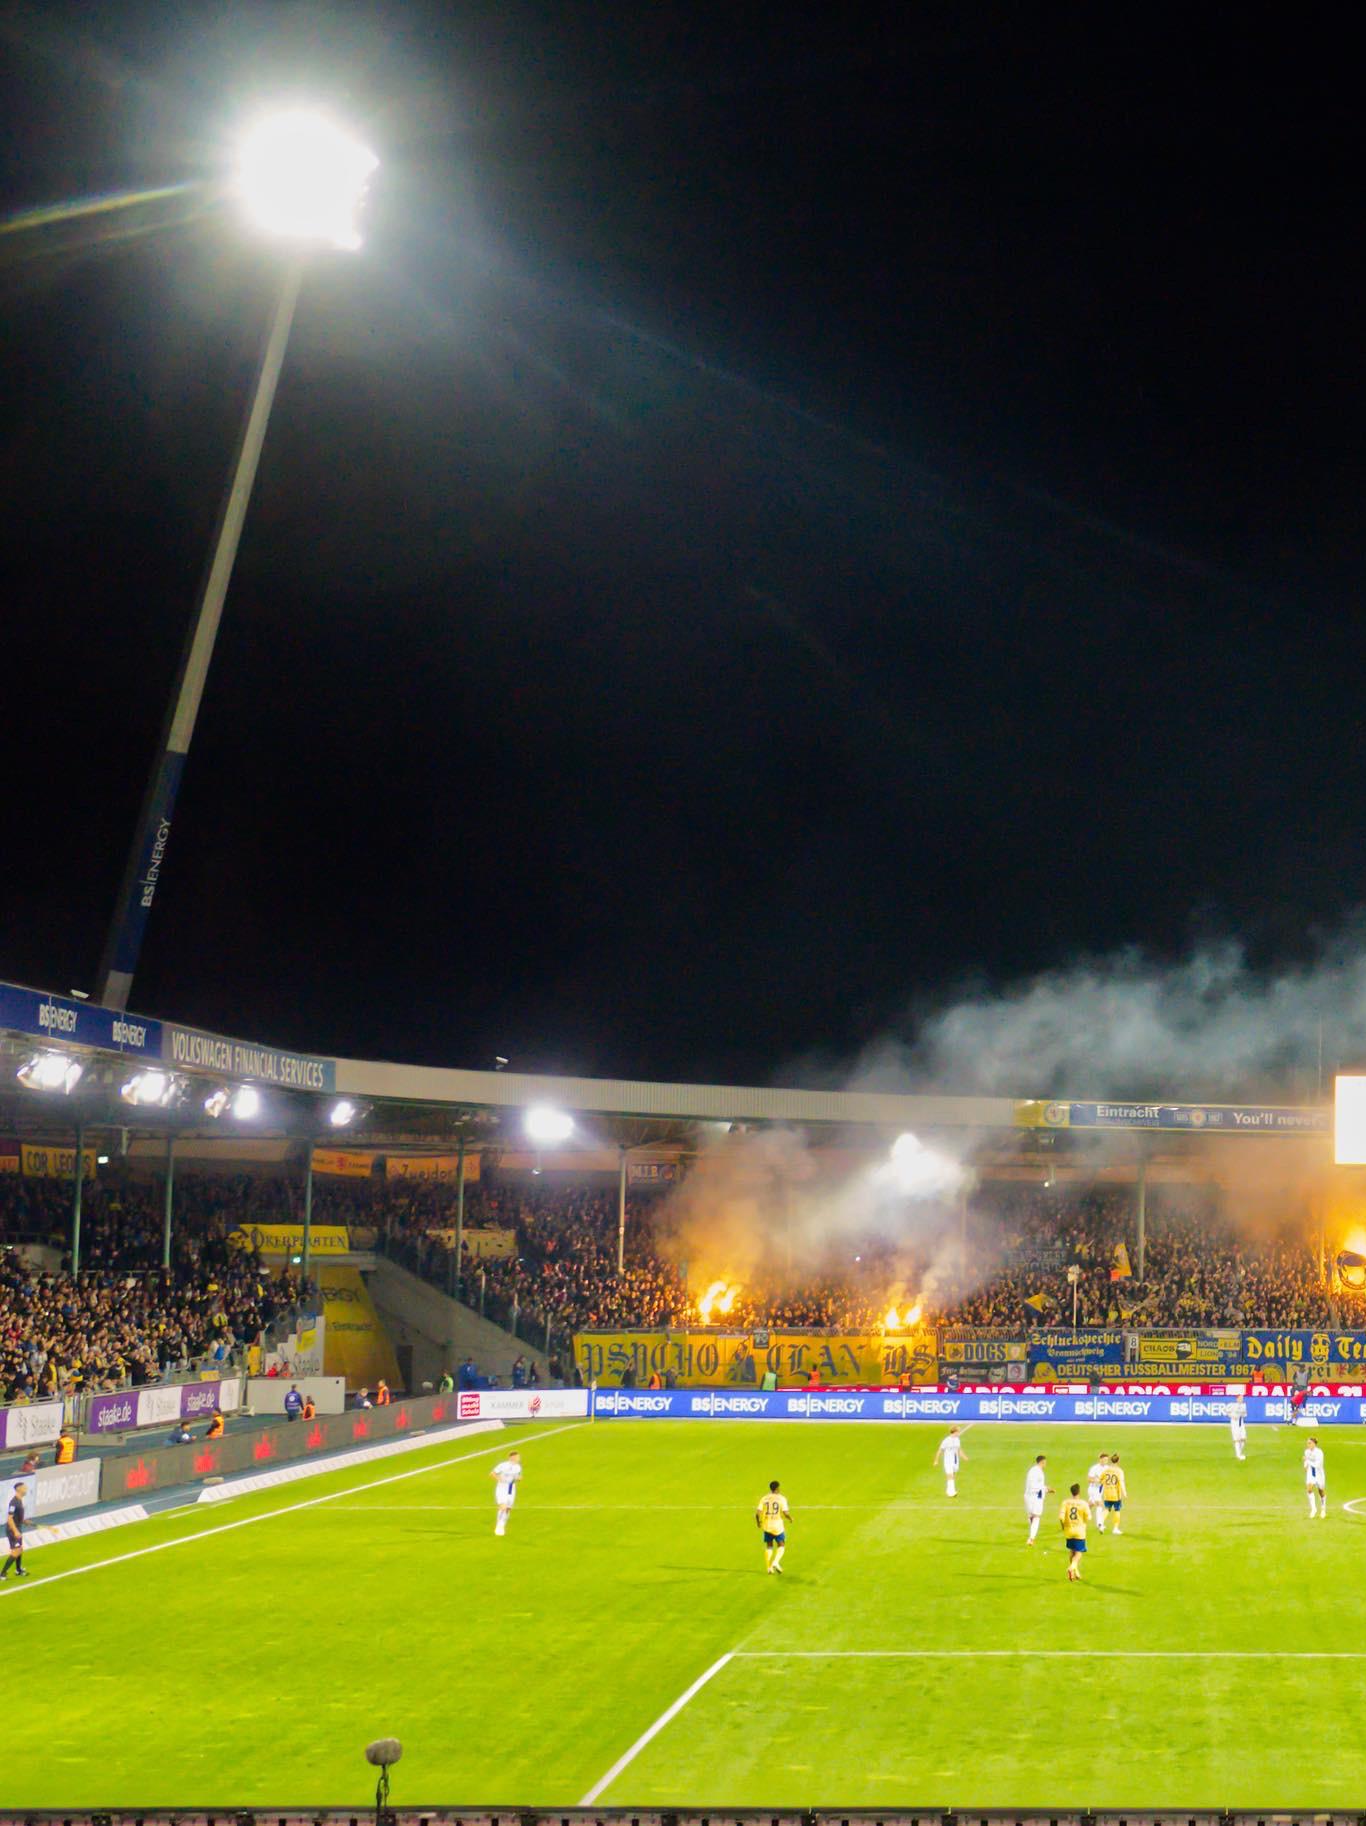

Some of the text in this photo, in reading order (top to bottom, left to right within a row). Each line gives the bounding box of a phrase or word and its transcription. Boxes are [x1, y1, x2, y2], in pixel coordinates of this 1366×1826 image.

[172, 1031, 324, 1088] VOLKSWAGEN FINANCIAL SERVICES
[1096, 1105, 1160, 1119] Eintracht
[964, 1343, 1007, 1361] DOGS
[1247, 1334, 1303, 1361] Daily
[581, 1341, 719, 1383] PSYCHO
[766, 1342, 866, 1378] CLAN
[1124, 1363, 1226, 1376] FUSSBALLMEISTER
[1230, 1362, 1255, 1376] 1967
[98, 1402, 132, 1428] staake.de
[1105, 1473, 1119, 1486] 20
[765, 1501, 779, 1515] 19
[1069, 1506, 1078, 1521] 8
